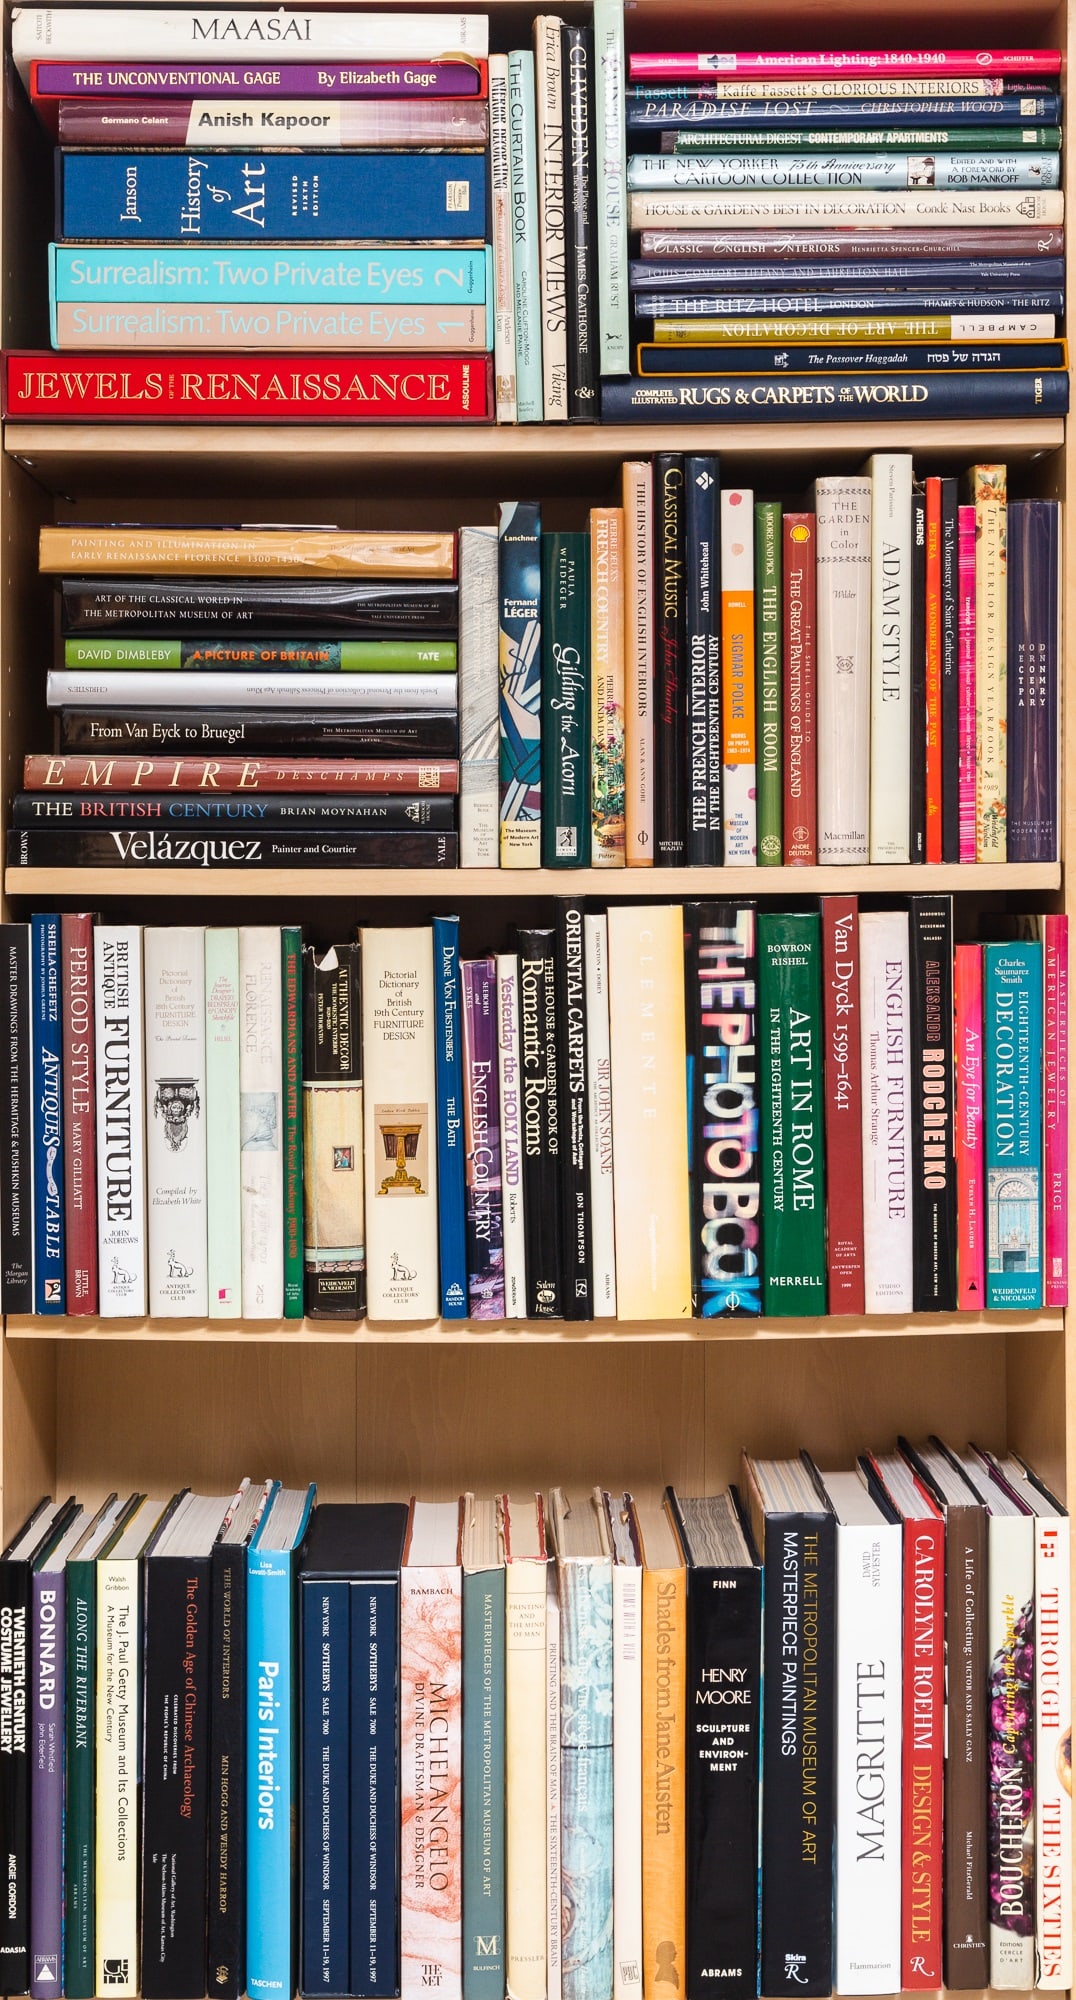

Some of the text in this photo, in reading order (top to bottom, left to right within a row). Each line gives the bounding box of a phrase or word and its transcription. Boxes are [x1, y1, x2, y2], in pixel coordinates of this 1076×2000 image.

[192, 18, 312, 41] MAASAI
[73, 72, 281, 85] THE UNCONVENTIONAL GAGE
[318, 71, 437, 87] By Elizabeth Gage
[198, 112, 330, 129] Anish Kapoor
[120, 167, 141, 222] Janson
[181, 156, 207, 234] History
[206, 184, 230, 204] of
[232, 162, 267, 228] Art
[948, 174, 1019, 183] BOB MANKOFF
[544, 26, 567, 406] Erica Brown INTERIOR VIEWS Viking
[959, 323, 1037, 332] CAMPBELL
[808, 353, 908, 366] The Passover Haggadah
[927, 350, 1001, 363] הגדה של פסח
[18, 373, 452, 401] JEWELS RENAISSANCE
[680, 385, 928, 405] RUGS & CARPETS WORLD
[1034, 378, 1042, 405] TIGER
[663, 468, 683, 618] CLASSICAL MUSIC
[916, 508, 924, 546] ATHENS
[504, 598, 538, 606] Fernand
[504, 608, 538, 618] LÉGER
[882, 542, 900, 702] ADAM STYLE
[942, 519, 954, 676] The Monastery of Saint Catherine
[78, 650, 440, 662] DAVID DIMBLEBY TATE
[193, 650, 329, 661] A PICTURE OF BRITAIN
[762, 586, 778, 772] THE ENGLISH ROOM
[91, 723, 245, 743] From Van Eyck to Bruegel
[551, 643, 584, 796] Gilding the Acorn
[43, 760, 406, 788] EMPIRE DESCHAMPS
[32, 802, 388, 818] THE BRITISH CENTURY BRIAN MOYNAHAN
[109, 831, 357, 867] Velázquez Painter and Courtier
[437, 836, 446, 862] YALE
[767, 944, 811, 952] BOWRON
[834, 913, 853, 953] Van
[48, 924, 58, 1022] SHEILA CHEFETZ
[102, 941, 115, 1009] ANTIQUE
[117, 941, 128, 1008] BRITISH
[771, 958, 808, 966] RISHEL
[832, 961, 854, 1016] Dyck
[70, 947, 89, 1209] PERIOD STYLE MARY GILLIATT
[521, 958, 546, 1155] Romantic Rooms
[996, 992, 1014, 1157] DECORATION
[1018, 991, 1029, 1156] EIGHTEENTH-CENTURY
[566, 909, 585, 1264] ORIENTAL CARPETS JON THOMPSON
[790, 1007, 814, 1211] ART IN ROME
[885, 960, 905, 1219] ENGLISH FURNITURE
[104, 1016, 132, 1221] FURNITURE
[770, 1276, 822, 1286] MERRELL
[713, 1580, 737, 1588] FINN
[40, 1590, 56, 1709] BONNARD
[782, 1532, 798, 1756] MASTERPIECE PAINTINGS
[0, 1607, 12, 1755] COSTUME JEWELLERY
[14, 1607, 26, 1753] TWENTIETH CENTURY
[75, 1598, 87, 1748] ALONG THE RIVERBANK
[696, 1690, 751, 1704] MOORE
[702, 1668, 747, 1682] HENRY
[656, 1582, 676, 1835] Shades from Jane Austen
[258, 1661, 280, 1830] Paris Interiors
[857, 1660, 885, 1862] MAGRITTE
[912, 1535, 934, 1942] CAROLYNE ROEHM DESIGN & STYLE
[430, 1682, 448, 1891] MICHELANGELO
[1040, 1587, 1062, 1977] THROUGH THE SIXTIES
[1000, 1767, 1024, 1916] BOUCHERON
[8, 1854, 17, 1919] ANGIE GORDON
[251, 1978, 282, 1988] TASCHEN
[701, 1968, 743, 1976] ABRAMS
